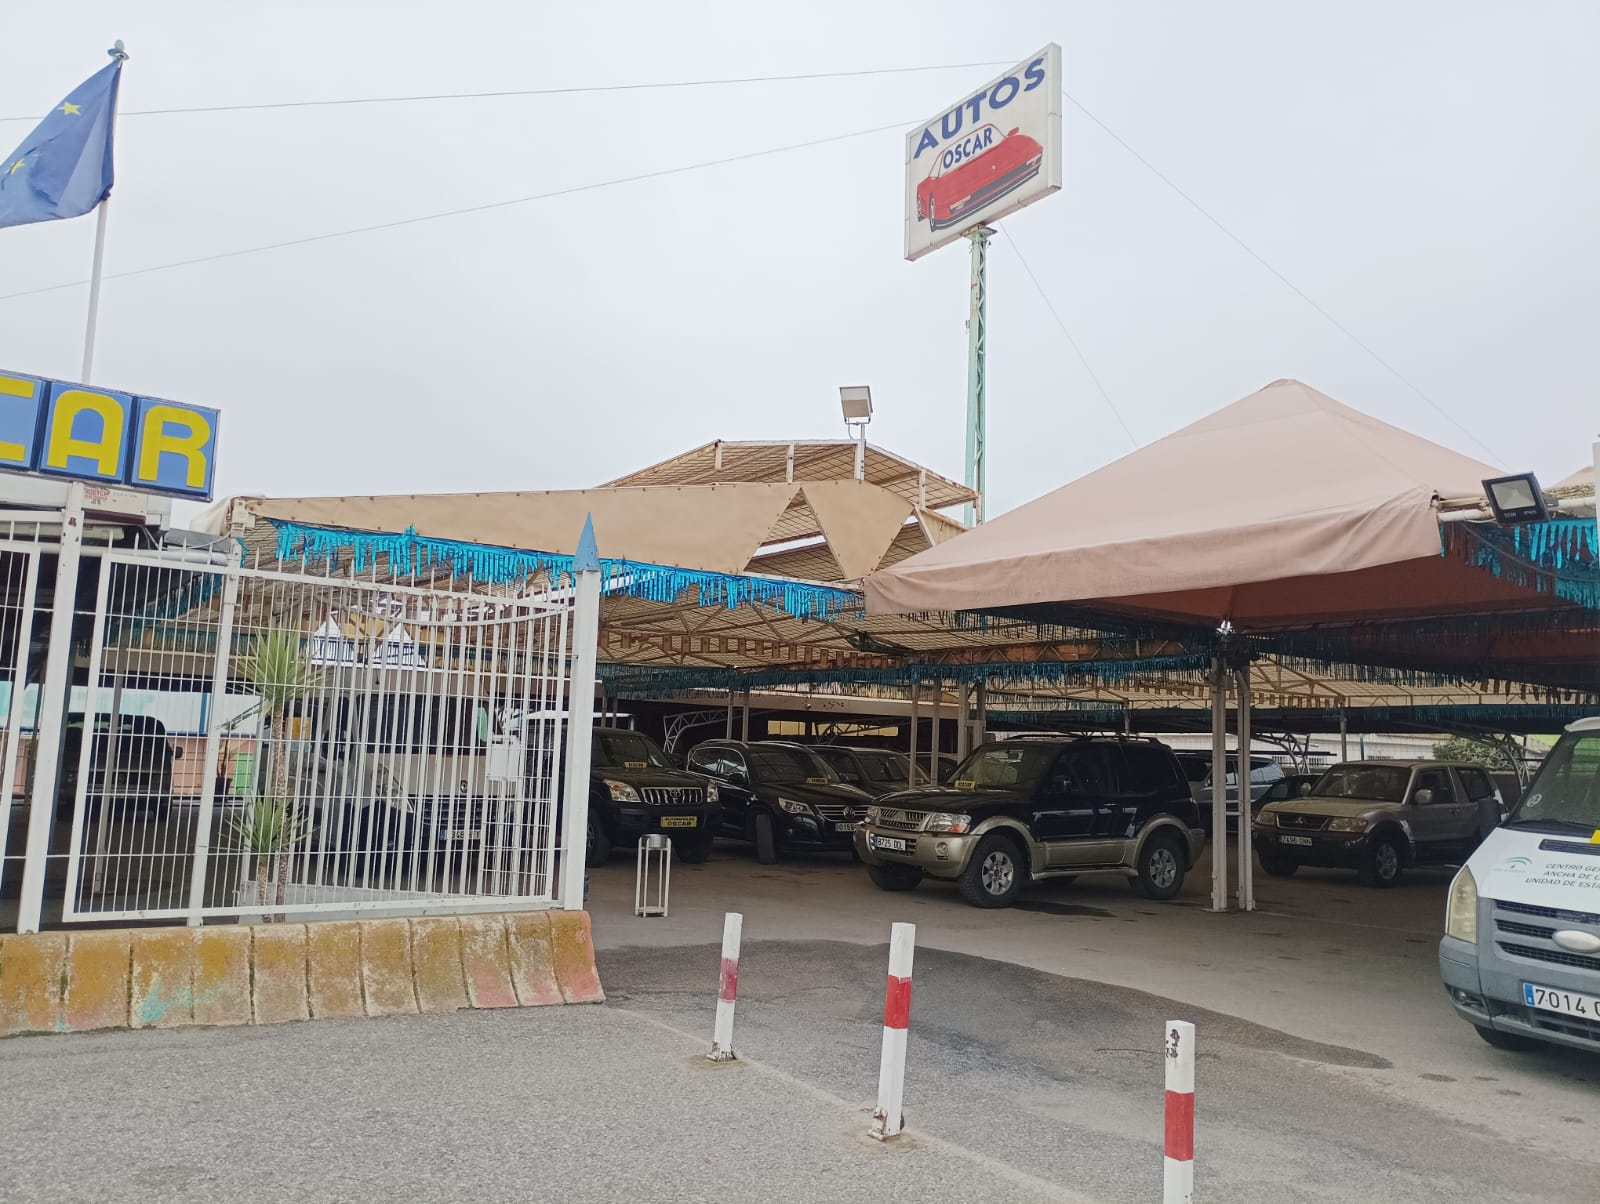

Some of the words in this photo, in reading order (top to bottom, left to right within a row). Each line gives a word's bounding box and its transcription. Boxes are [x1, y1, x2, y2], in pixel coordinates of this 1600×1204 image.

[913, 57, 1046, 160] AUTOS
[943, 127, 993, 169] OSCAR
[1545, 863, 1583, 871] CENTRO
[1525, 877, 1561, 885] UNIDAD
[1535, 988, 1587, 1015] 7014
